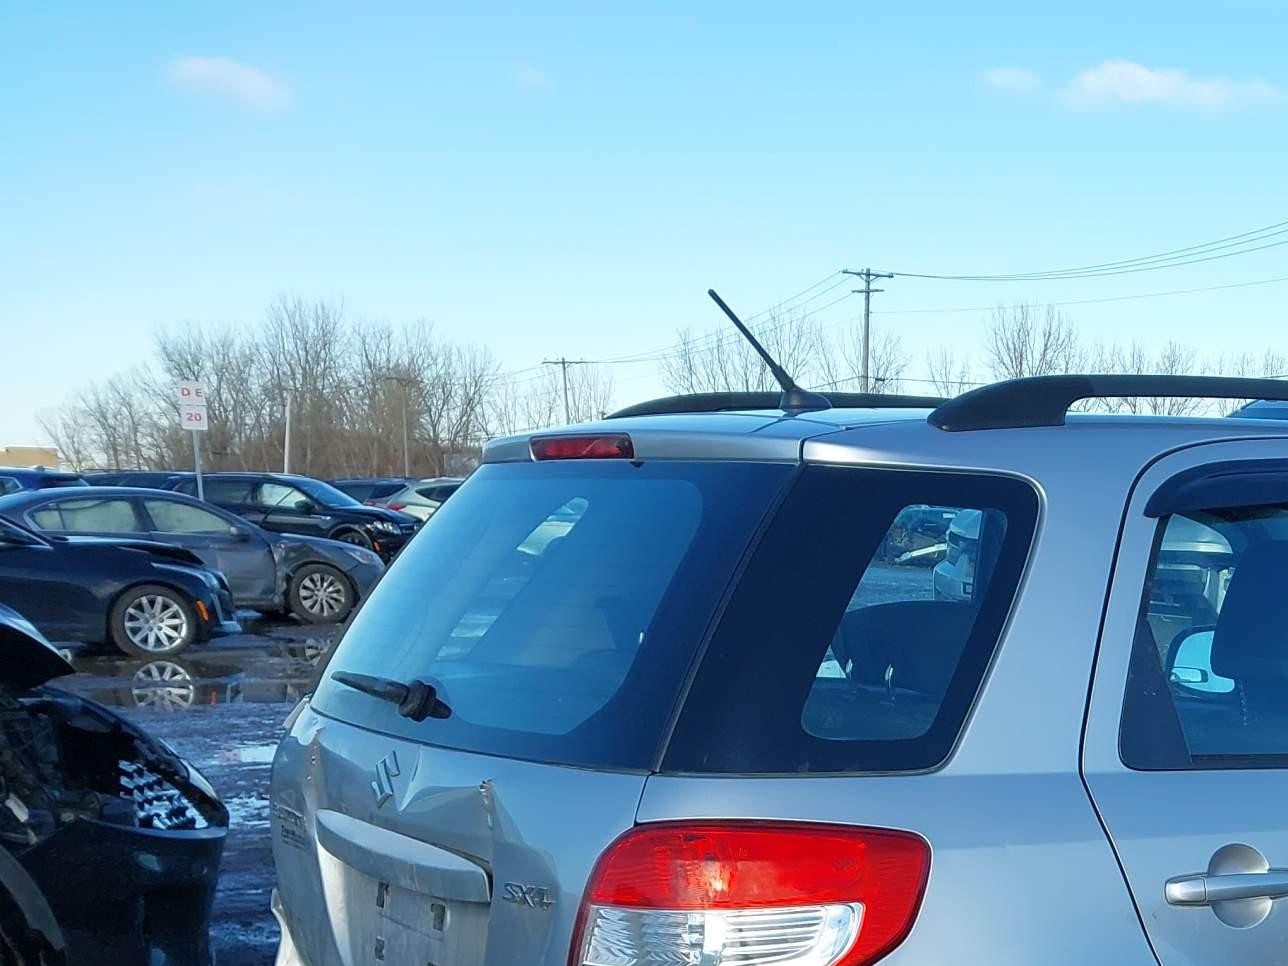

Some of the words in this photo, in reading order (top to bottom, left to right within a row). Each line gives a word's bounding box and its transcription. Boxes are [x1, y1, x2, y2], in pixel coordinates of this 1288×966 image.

[181, 387, 191, 397] D
[195, 388, 203, 398] E
[185, 412, 202, 422] 20
[502, 881, 556, 911] SX4
